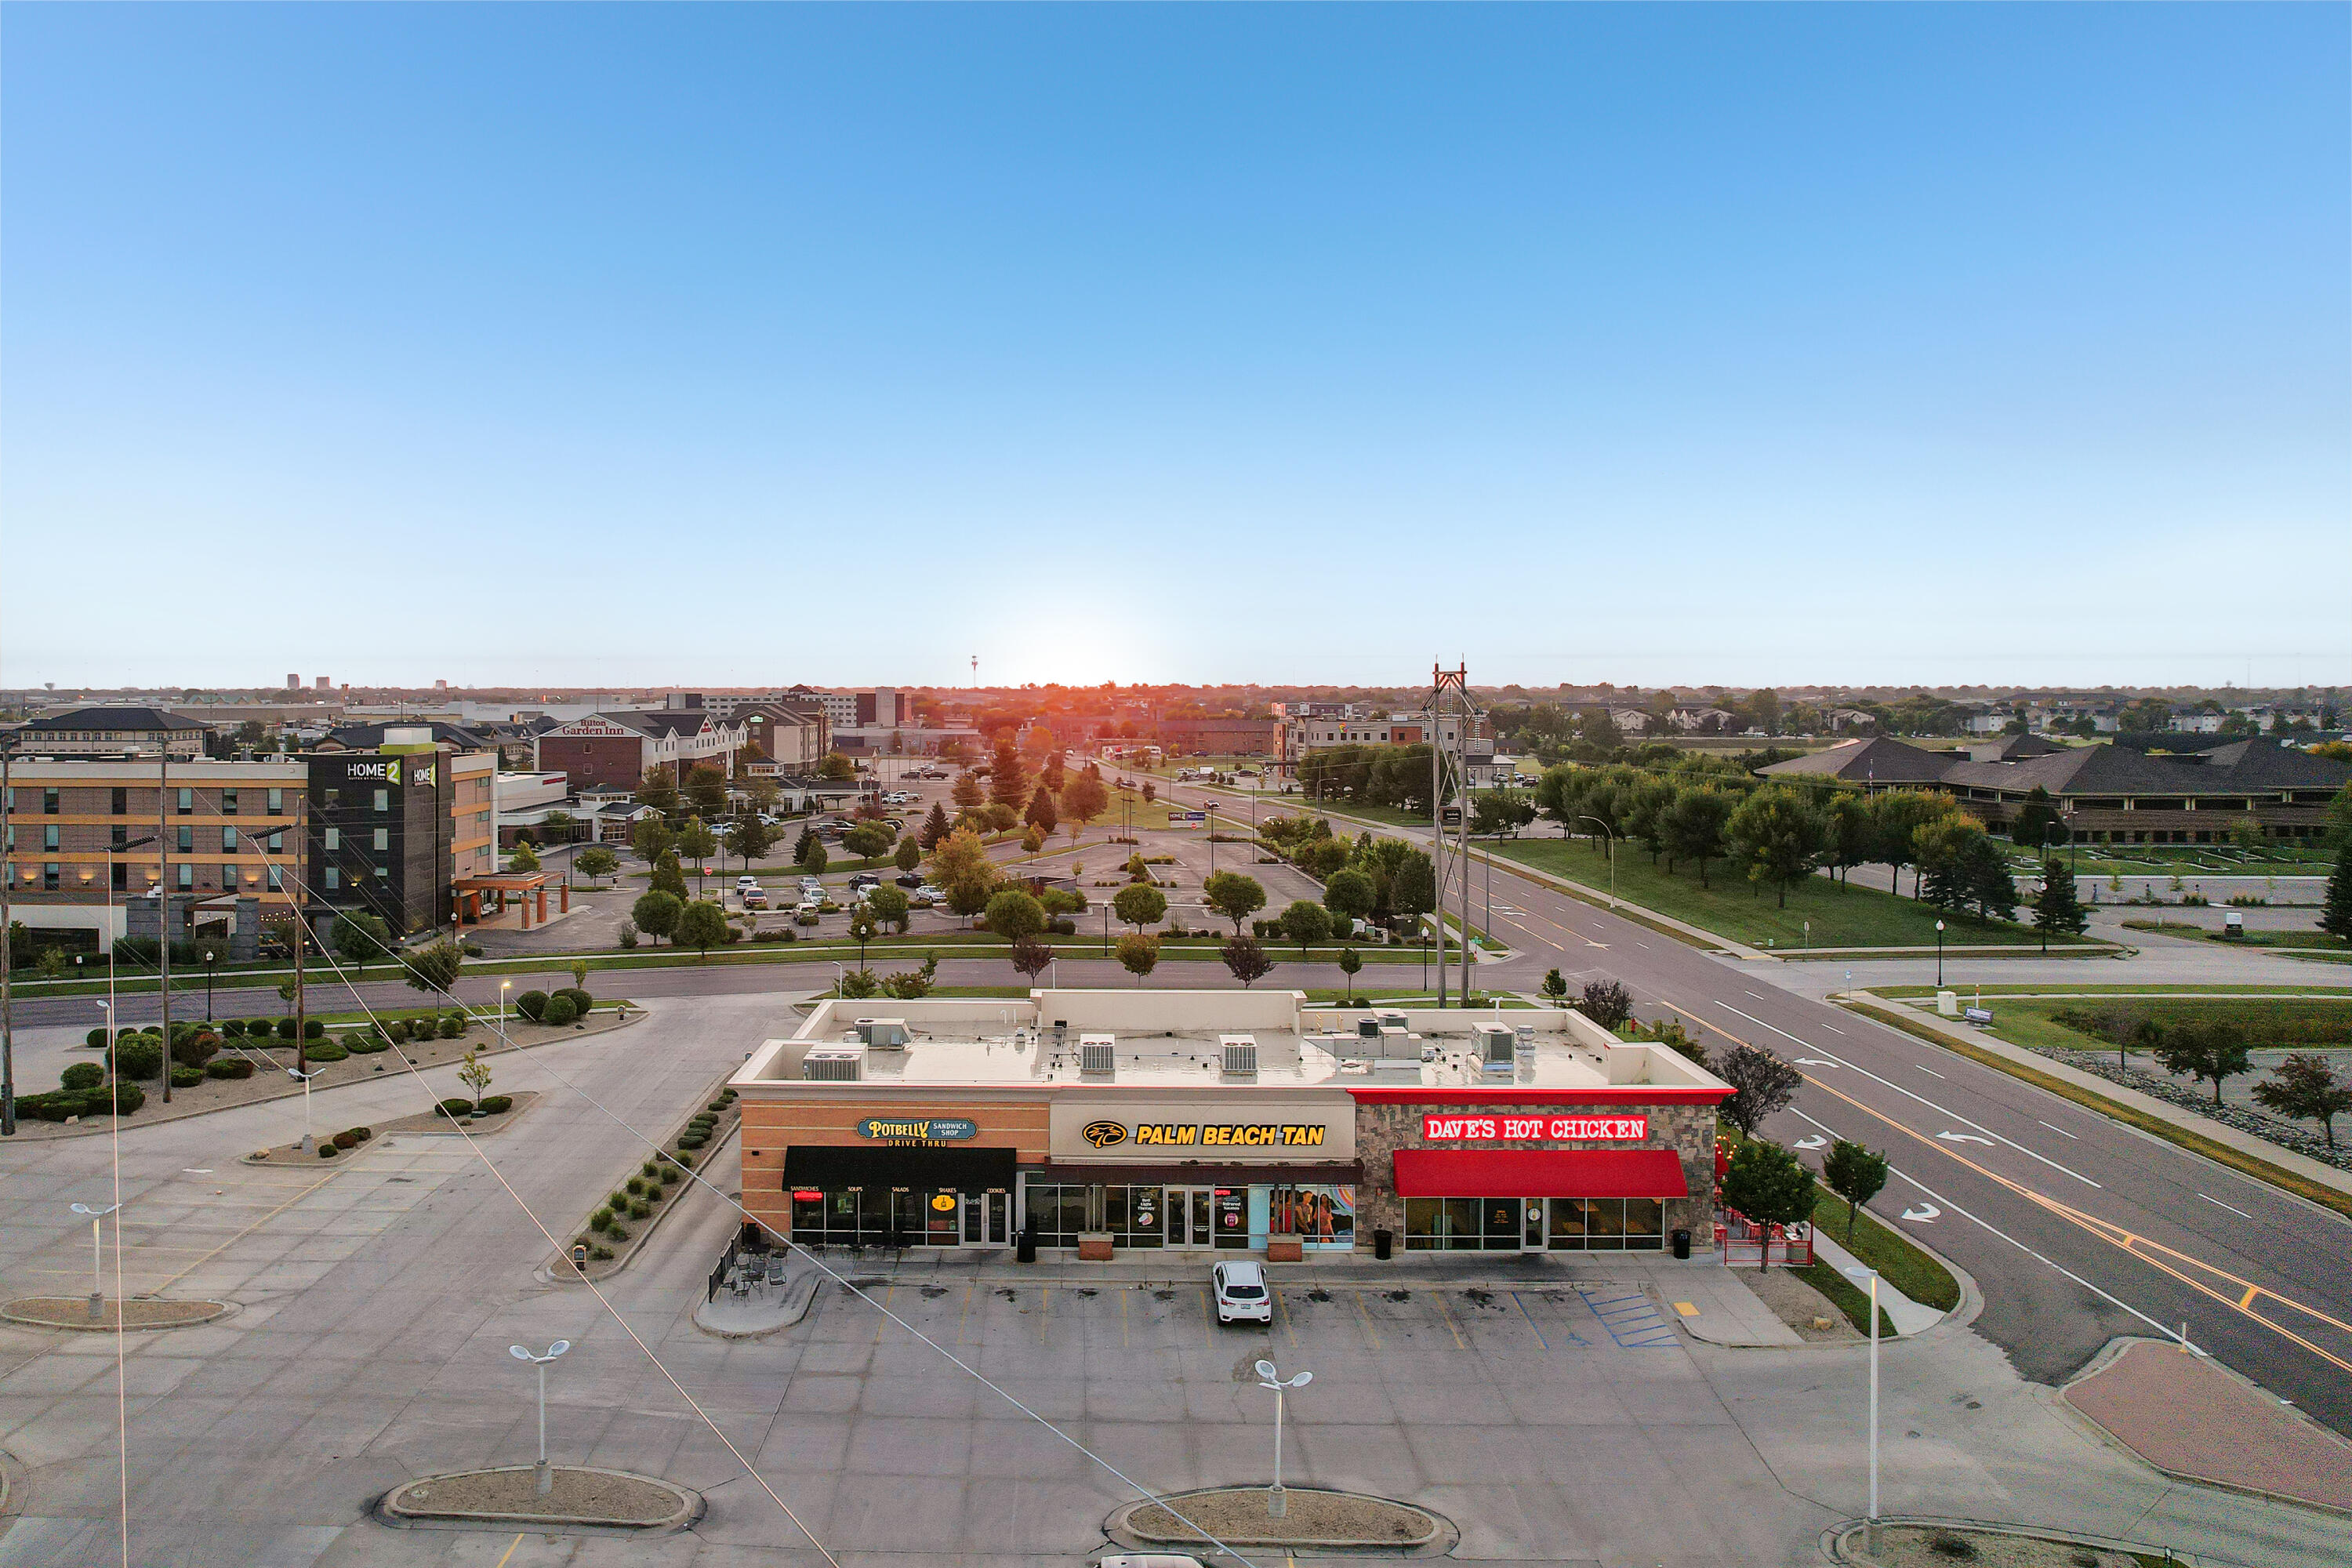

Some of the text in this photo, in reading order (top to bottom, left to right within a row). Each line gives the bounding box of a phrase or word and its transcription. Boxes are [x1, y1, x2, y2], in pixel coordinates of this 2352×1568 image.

[562, 726, 624, 735] Garden Inn
[347, 762, 399, 782] HOME 2
[413, 768, 430, 782] HOME
[868, 1121, 931, 1139] POTBELLY
[1136, 1125, 1325, 1145] PALM BEACH TAN
[1428, 1119, 1646, 1138] DAVE'S HOT CHICKEN
